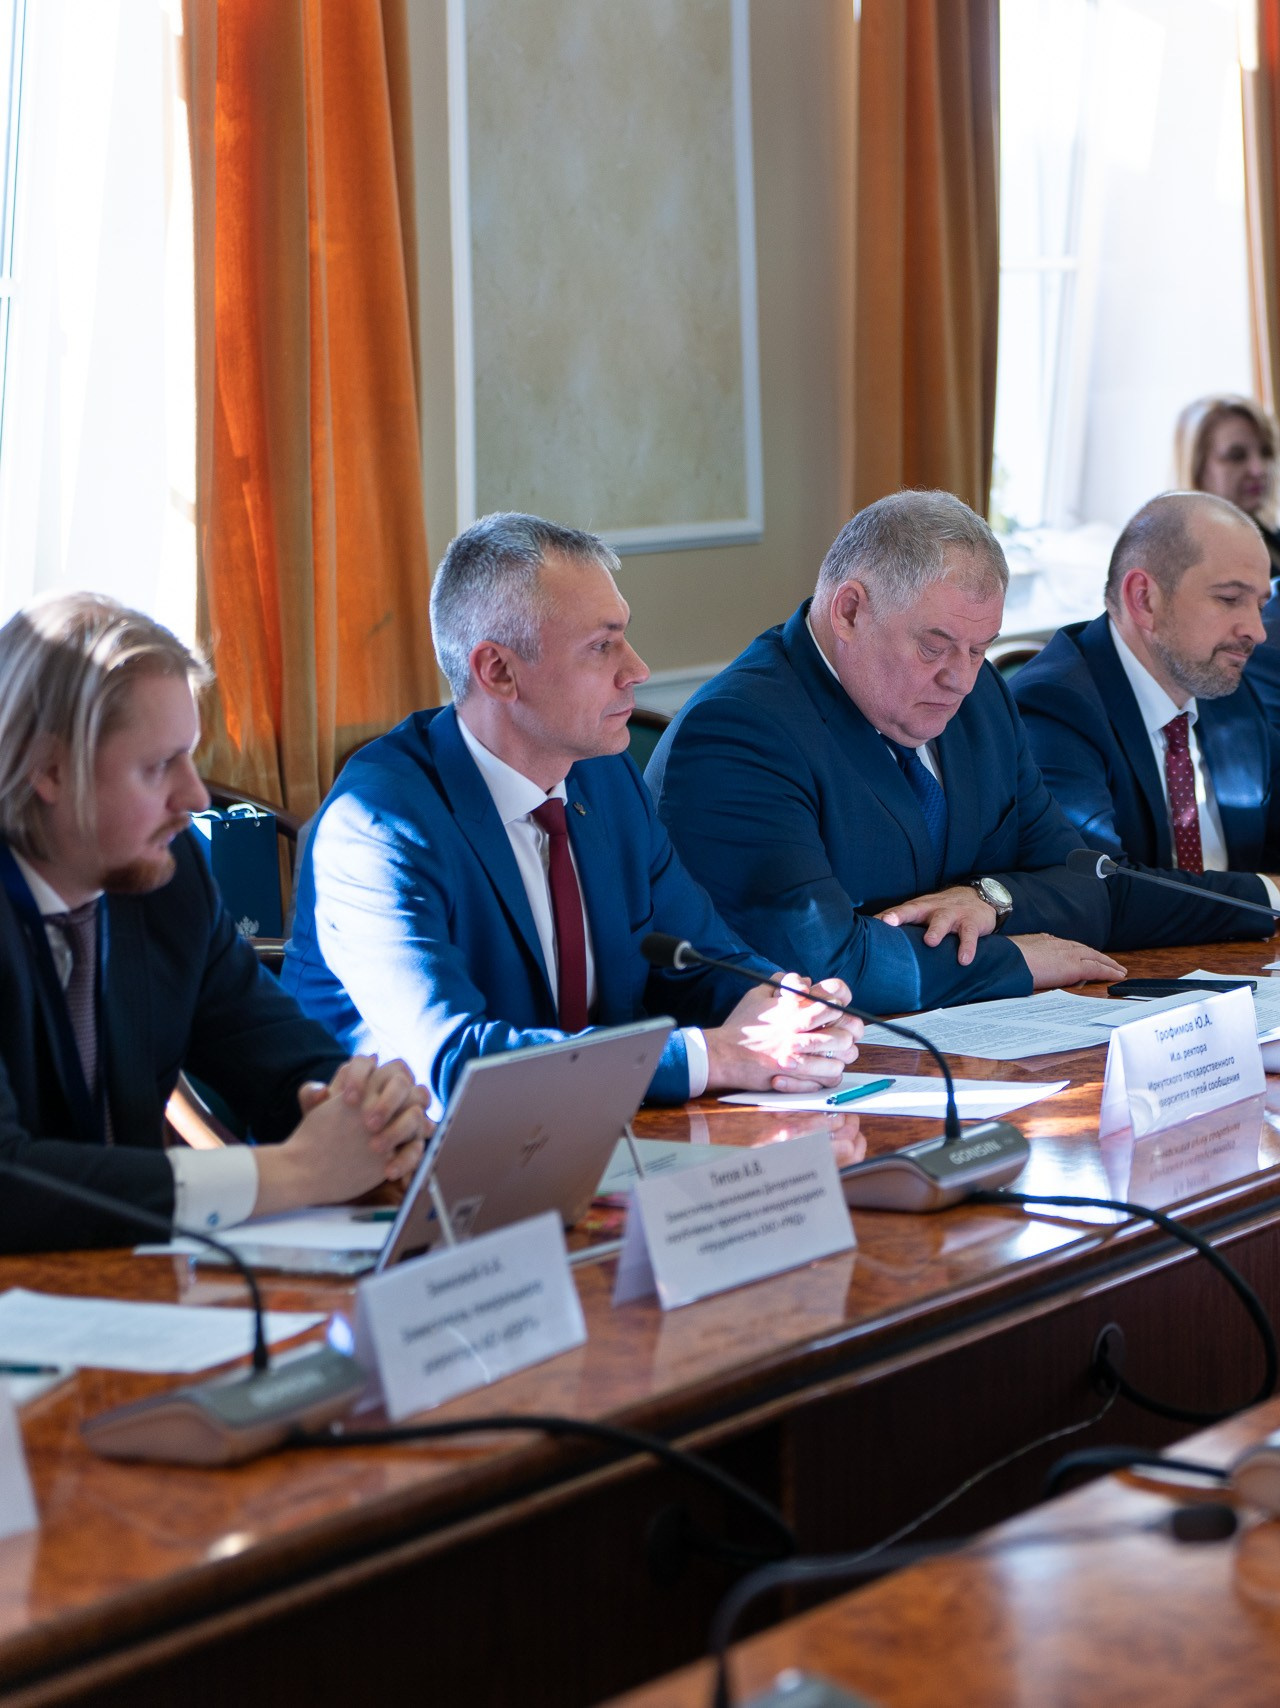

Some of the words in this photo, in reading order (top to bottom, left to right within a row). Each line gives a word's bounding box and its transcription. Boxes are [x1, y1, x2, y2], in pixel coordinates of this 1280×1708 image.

[1155, 1022, 1194, 1044] Трофимов
[1194, 1013, 1213, 1029] Ю.А.
[1169, 1051, 1183, 1062] И.о.
[1183, 1043, 1207, 1060] ректора
[1183, 1056, 1235, 1081] государственного
[1190, 1081, 1207, 1098] путей
[1208, 1073, 1240, 1092] сообщения
[949, 1139, 1002, 1165] GONSIN
